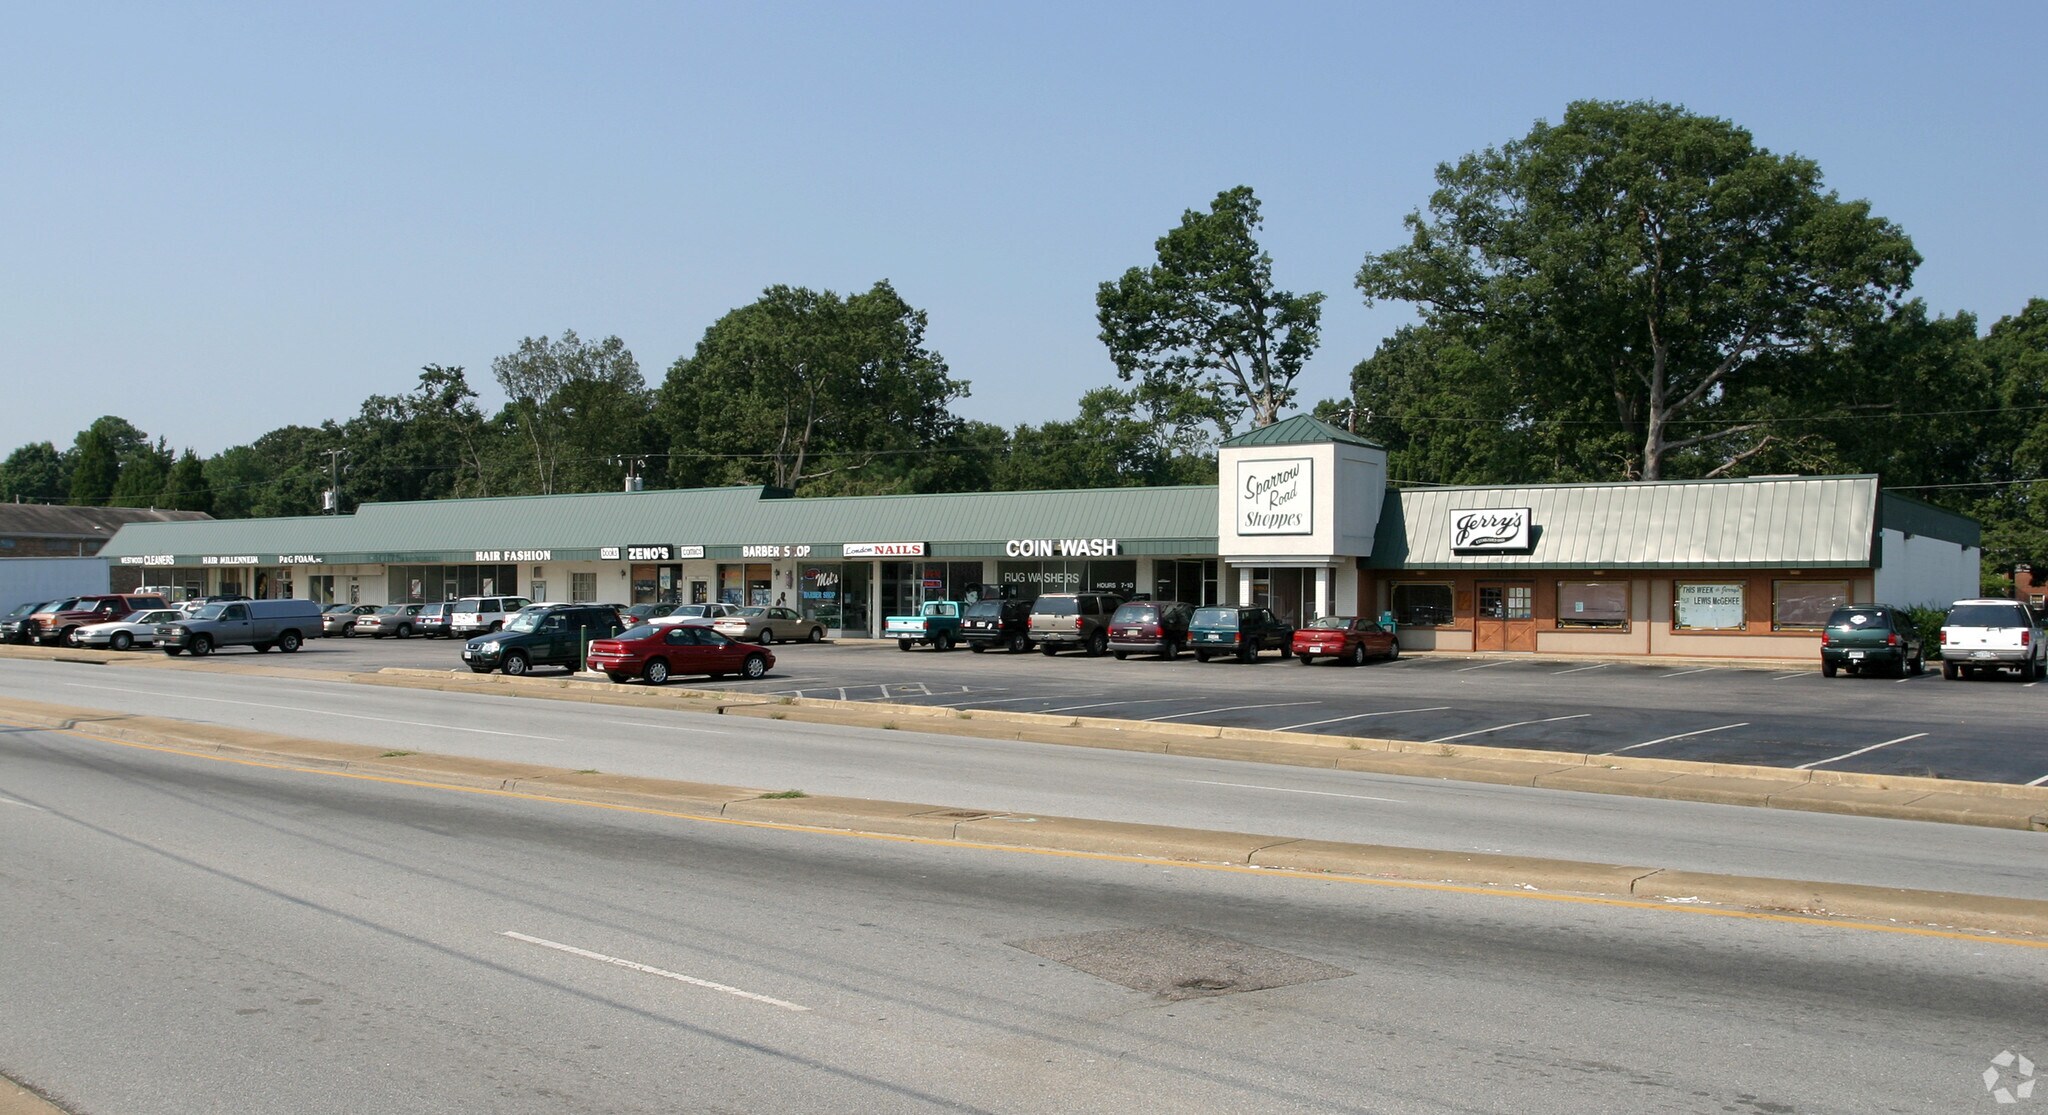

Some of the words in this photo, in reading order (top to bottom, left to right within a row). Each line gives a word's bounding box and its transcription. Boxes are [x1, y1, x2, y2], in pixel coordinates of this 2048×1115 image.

[1244, 463, 1299, 504] Sparrow
[1269, 480, 1297, 511] Road
[1244, 511, 1303, 529] Shoppes
[1456, 512, 1522, 546] Jerry's
[628, 547, 669, 560] ZENO'S
[743, 546, 779, 557] BARBER
[784, 545, 811, 557] SOP
[874, 545, 921, 554] NAILS
[1006, 539, 1053, 557] COIN
[1060, 538, 1116, 557] WASH
[144, 555, 174, 565] CLEANERS
[203, 556, 218, 564] HAIR
[476, 551, 501, 561] HAIR
[504, 550, 551, 561] FASHION
[815, 572, 839, 587] Mel's
[1004, 573, 1026, 583] RUG
[1028, 573, 1080, 583] WASHERS
[1697, 586, 1713, 594] WEEK
[1694, 597, 1711, 605] LEWIS
